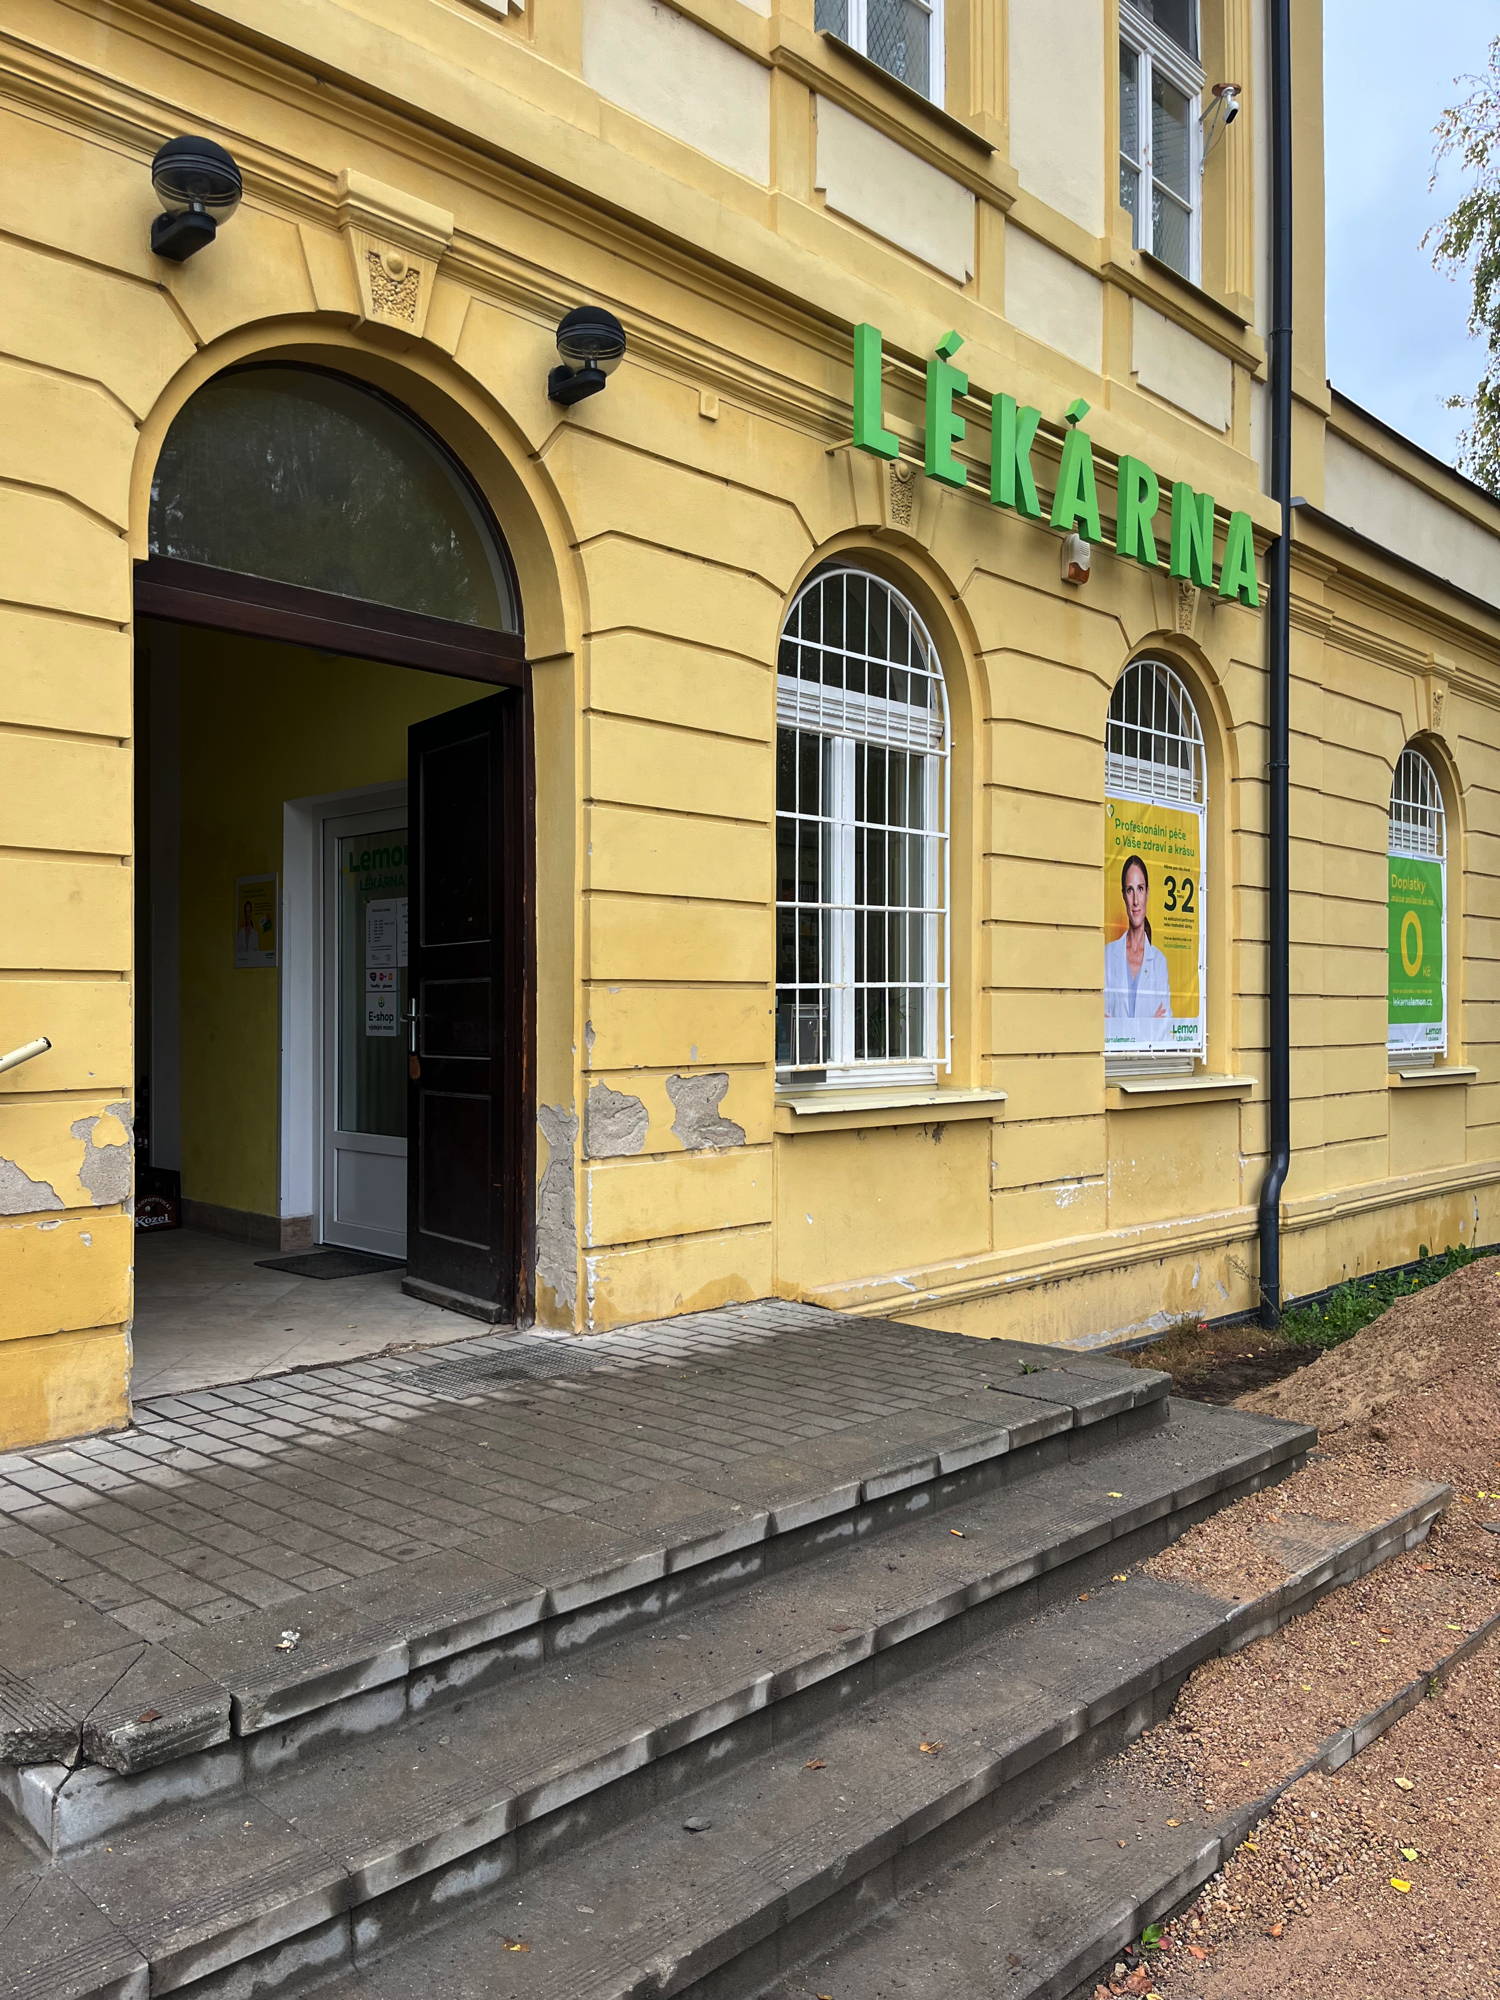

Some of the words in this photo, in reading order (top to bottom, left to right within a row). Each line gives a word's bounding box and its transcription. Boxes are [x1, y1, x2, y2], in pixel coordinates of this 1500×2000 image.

[853, 323, 1260, 608] LÉKÁRNA
[1115, 818, 1168, 838] Profesionální
[1169, 828, 1186, 840] péče
[1115, 837, 1121, 846] o
[1122, 835, 1142, 849] Vaše
[1143, 840, 1167, 853] zdraví
[1168, 845, 1173, 854] a
[1174, 844, 1195, 857] krásu
[359, 874, 405, 891] LÉKÁRNA
[1391, 873, 1427, 895] Doplatky
[1164, 875, 1177, 912] 3
[1181, 878, 1195, 913] 2
[1400, 910, 1423, 977] 0
[1422, 965, 1431, 977] Kč
[1393, 996, 1433, 1007] lekarnalemon.cz
[368, 1010, 395, 1024] E-shop
[1173, 1024, 1198, 1034] Lemon
[1425, 1026, 1442, 1036] Lemon
[135, 1213, 172, 1228] Kozel
